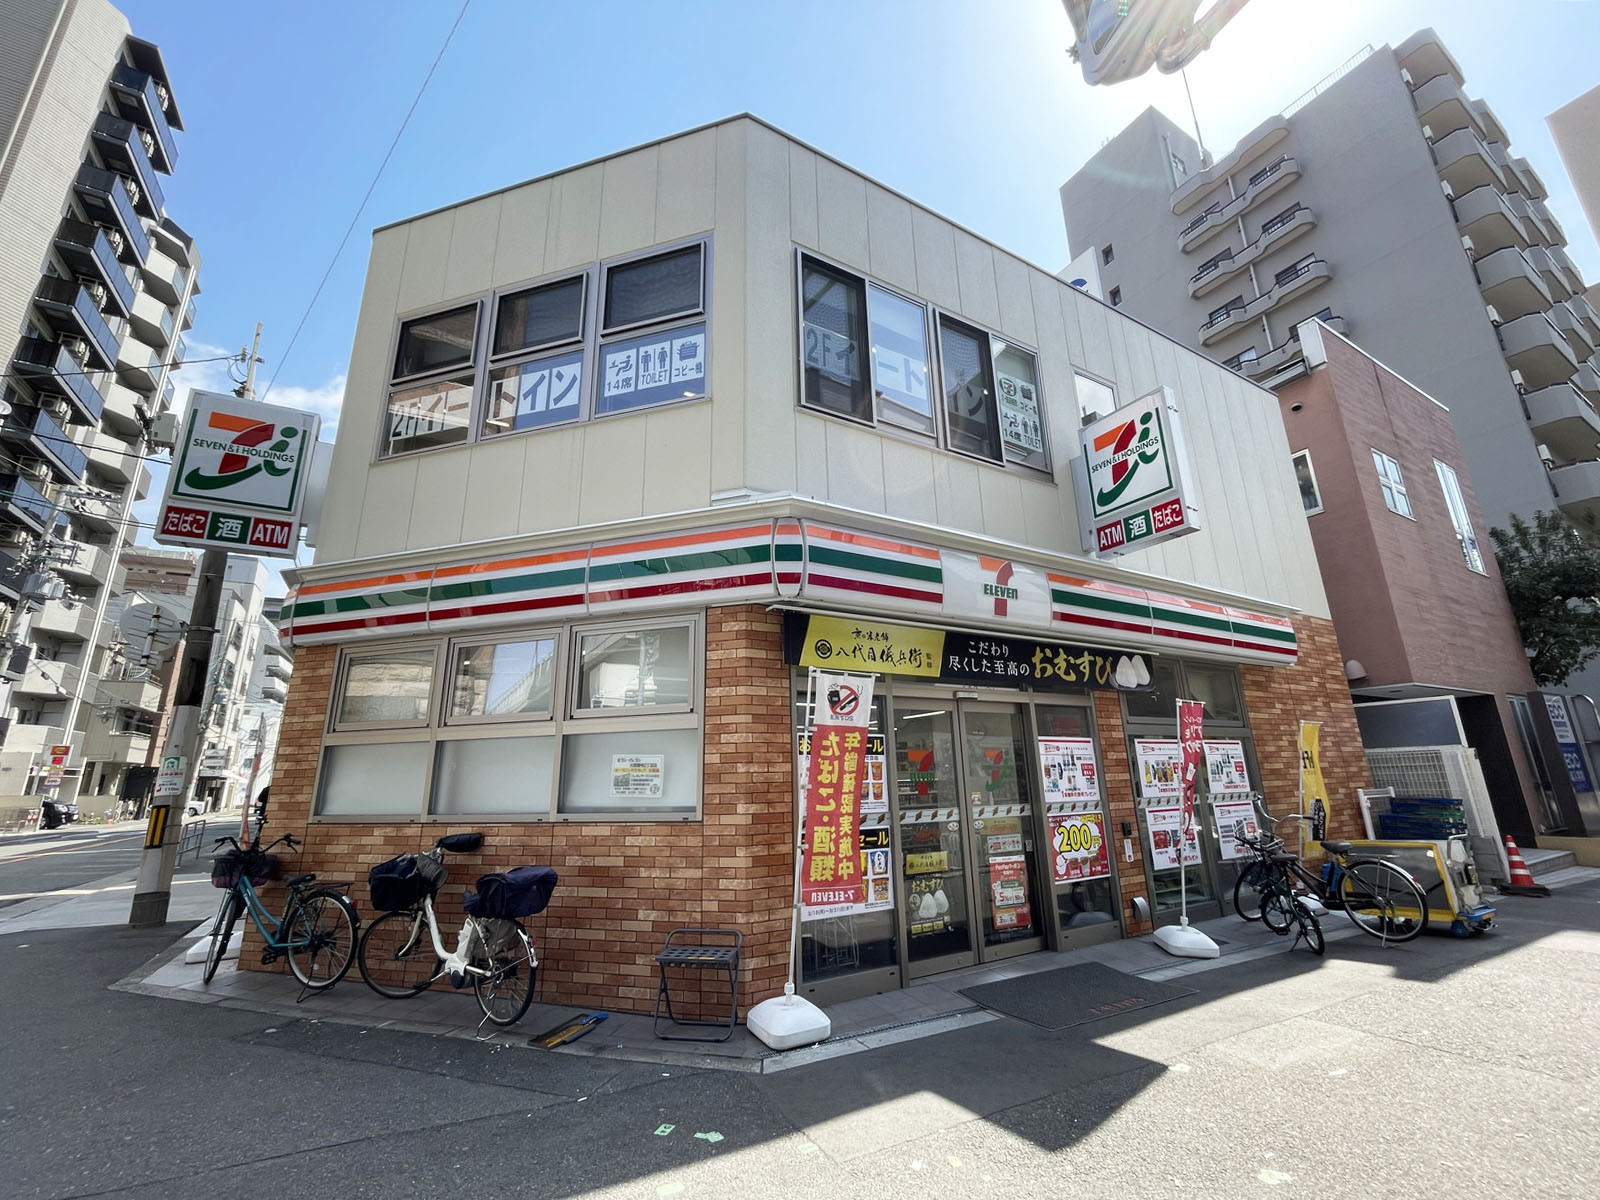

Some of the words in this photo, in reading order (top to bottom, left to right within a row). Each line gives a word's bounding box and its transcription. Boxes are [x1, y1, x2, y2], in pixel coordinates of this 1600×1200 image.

[606, 376, 633, 392] 14席
[641, 369, 669, 386] TOILET
[1023, 434, 1041, 449] TOILET
[1121, 436, 1160, 462] HOLDINGS
[243, 446, 296, 463] HOLDINGS
[163, 511, 206, 535] たばこ
[215, 516, 244, 540] 酒
[251, 522, 290, 546] ATM
[1099, 522, 1124, 549] ATM
[1128, 514, 1149, 539] 酒
[1153, 503, 1183, 530] たばこ
[967, 640, 1009, 658] こだわり
[948, 655, 1031, 677] 尽くした至高の
[1031, 645, 1114, 685] おむすび
[1057, 823, 1100, 853] 200円
